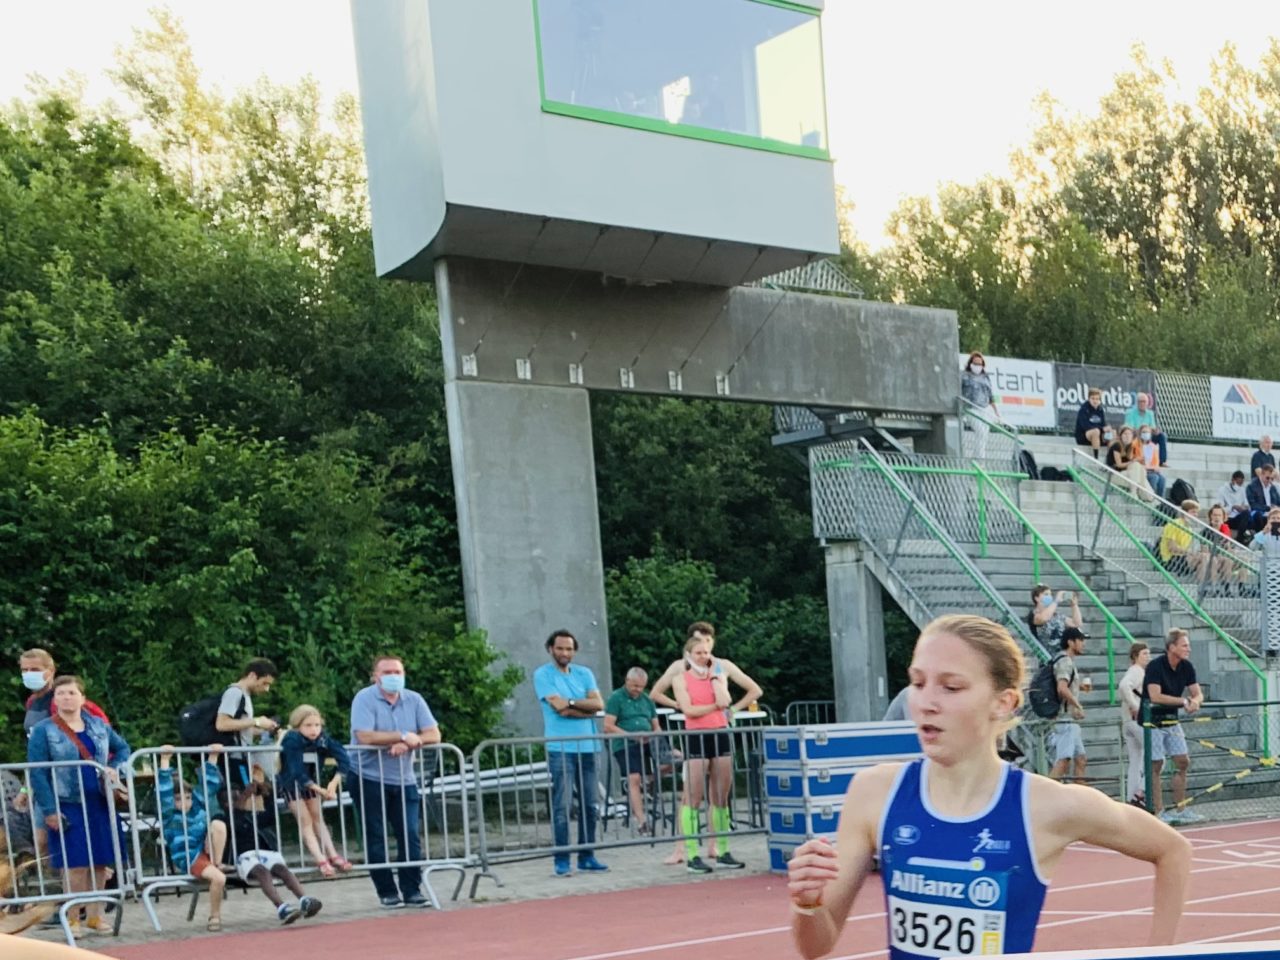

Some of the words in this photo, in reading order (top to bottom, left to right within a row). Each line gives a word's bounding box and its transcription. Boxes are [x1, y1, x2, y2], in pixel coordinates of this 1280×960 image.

[1056, 382, 1132, 409] pollntia
[891, 870, 965, 898] Allianz
[893, 907, 976, 955] 3526
